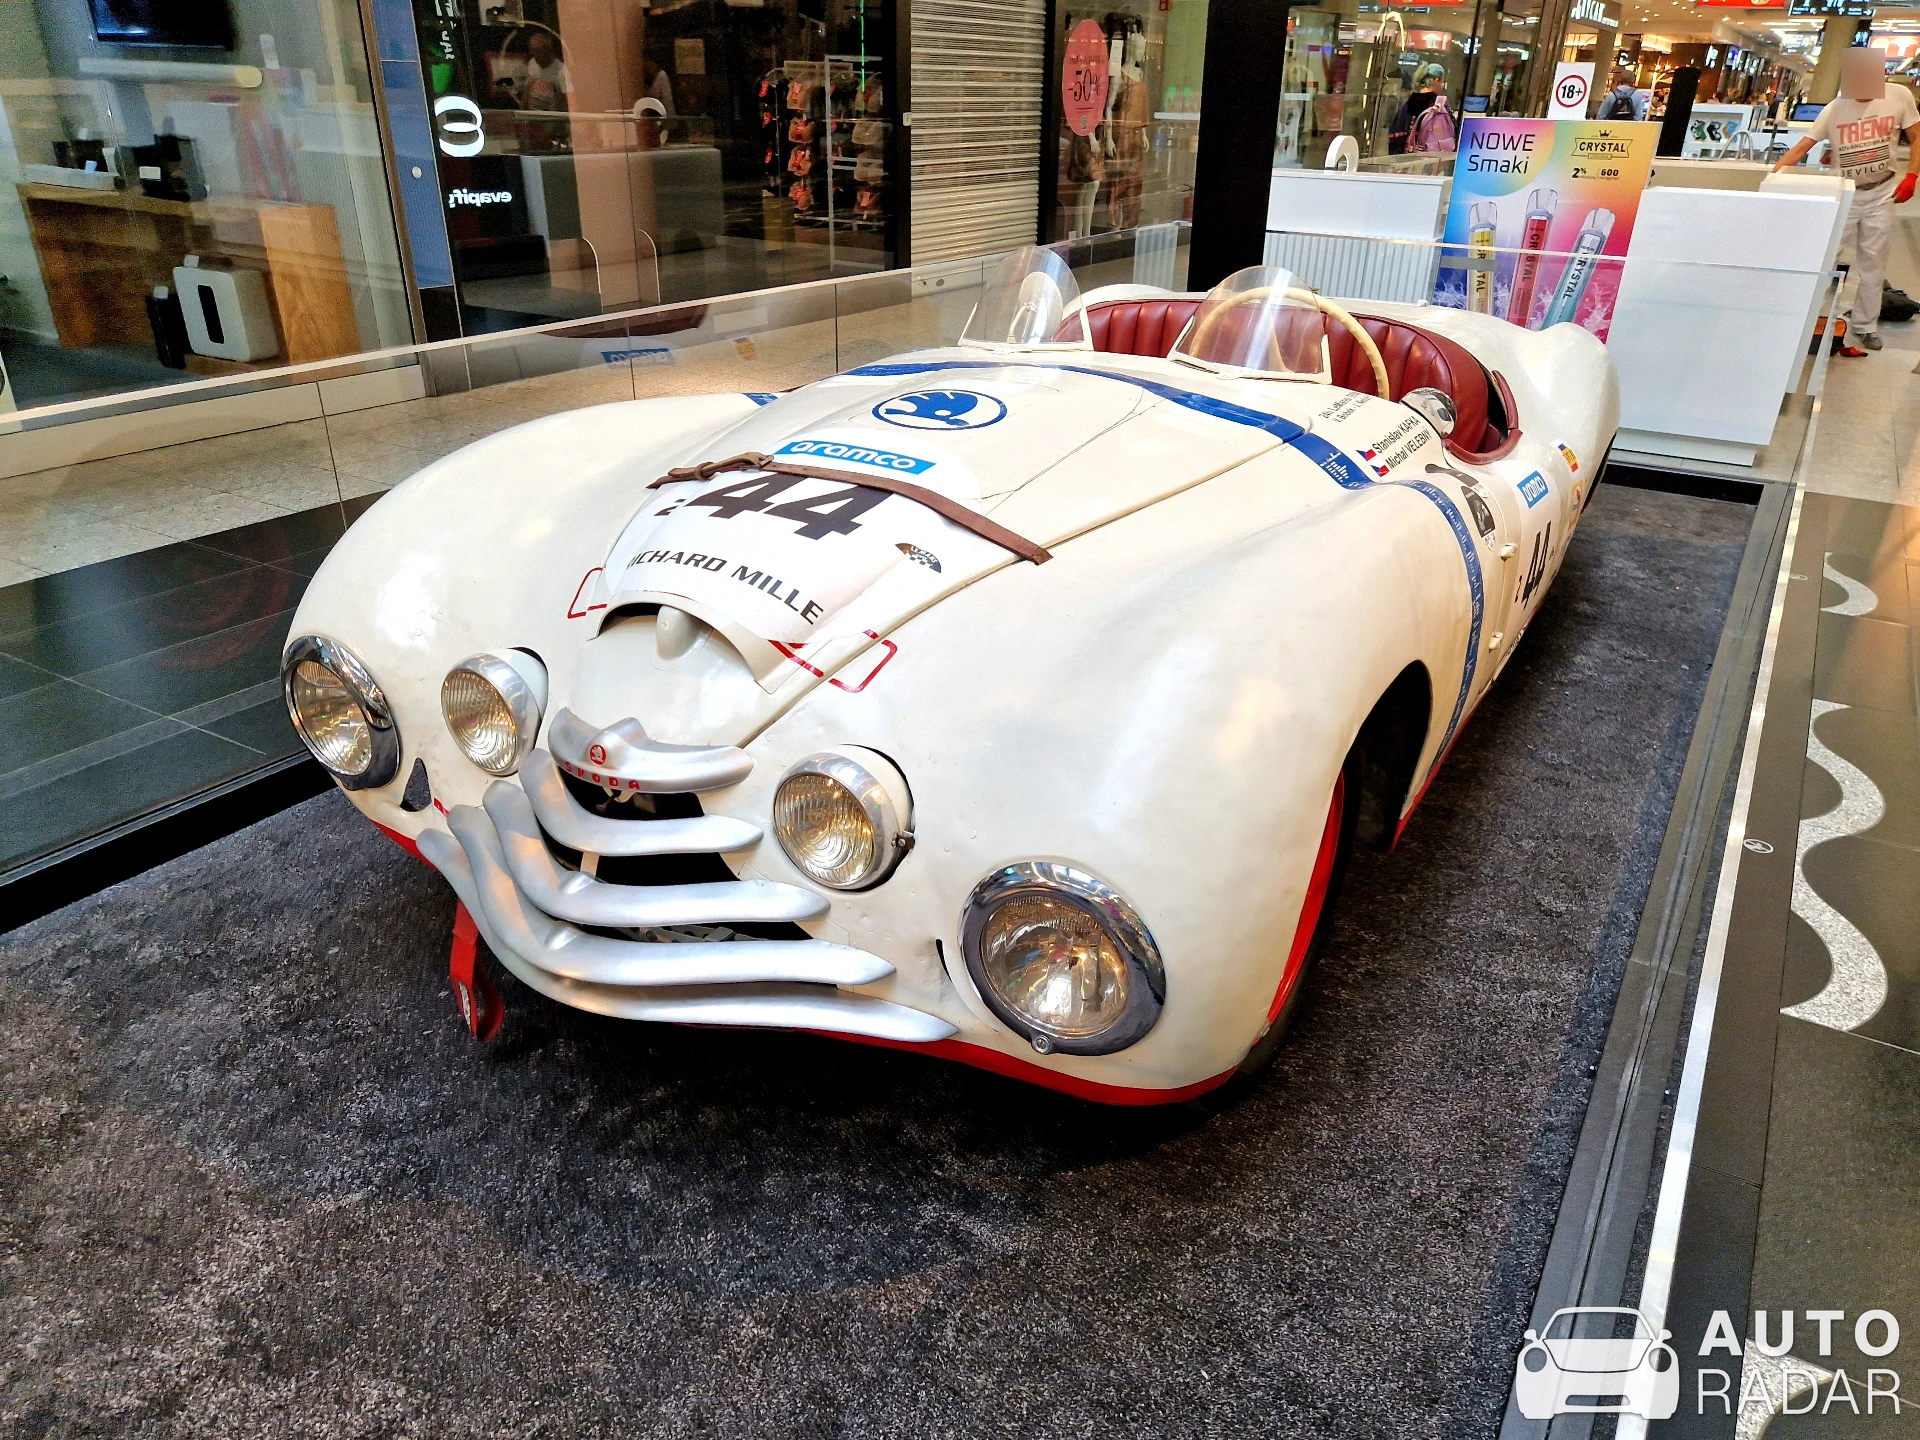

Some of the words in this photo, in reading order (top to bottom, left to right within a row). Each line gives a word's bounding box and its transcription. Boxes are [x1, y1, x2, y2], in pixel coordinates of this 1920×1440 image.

[1562, 85, 1583, 99] 18+
[1470, 132, 1536, 152] NOWE
[1578, 141, 1626, 153] CRYSTAL
[1467, 154, 1529, 174] Smaki
[1600, 168, 1619, 177] 600
[1521, 232, 1540, 283] CRSTAL
[1371, 430, 1402, 454] Stanislav
[1398, 416, 1421, 434] KAFKA
[790, 440, 917, 470] aramco
[1385, 450, 1409, 470] Michal
[683, 473, 894, 541] 44
[730, 565, 825, 626] MILLE
